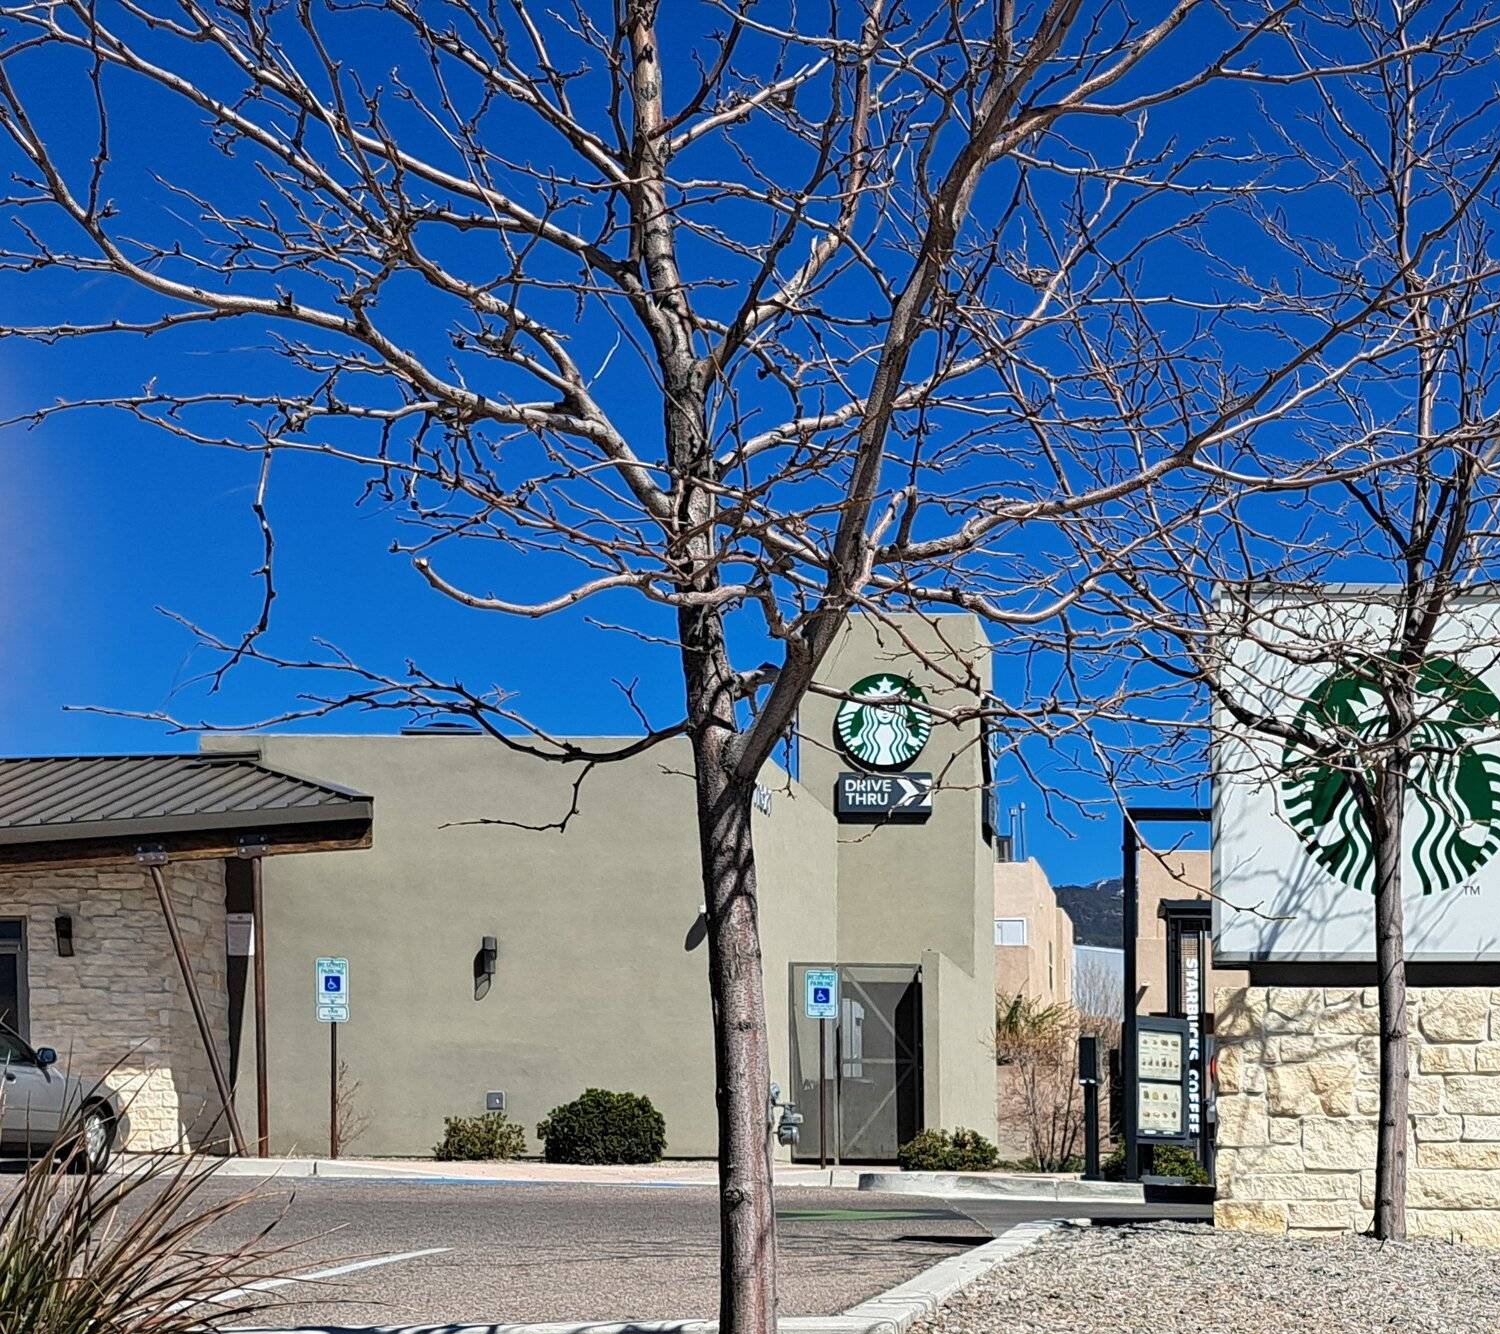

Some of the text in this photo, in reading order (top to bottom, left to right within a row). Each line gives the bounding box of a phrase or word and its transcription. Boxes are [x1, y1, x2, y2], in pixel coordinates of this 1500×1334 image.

[845, 779, 892, 792] DRIVE
[845, 793, 889, 806] THRU
[1462, 885, 1480, 896] TM
[1186, 958, 1200, 1134] STARBUCKS COFFEE
